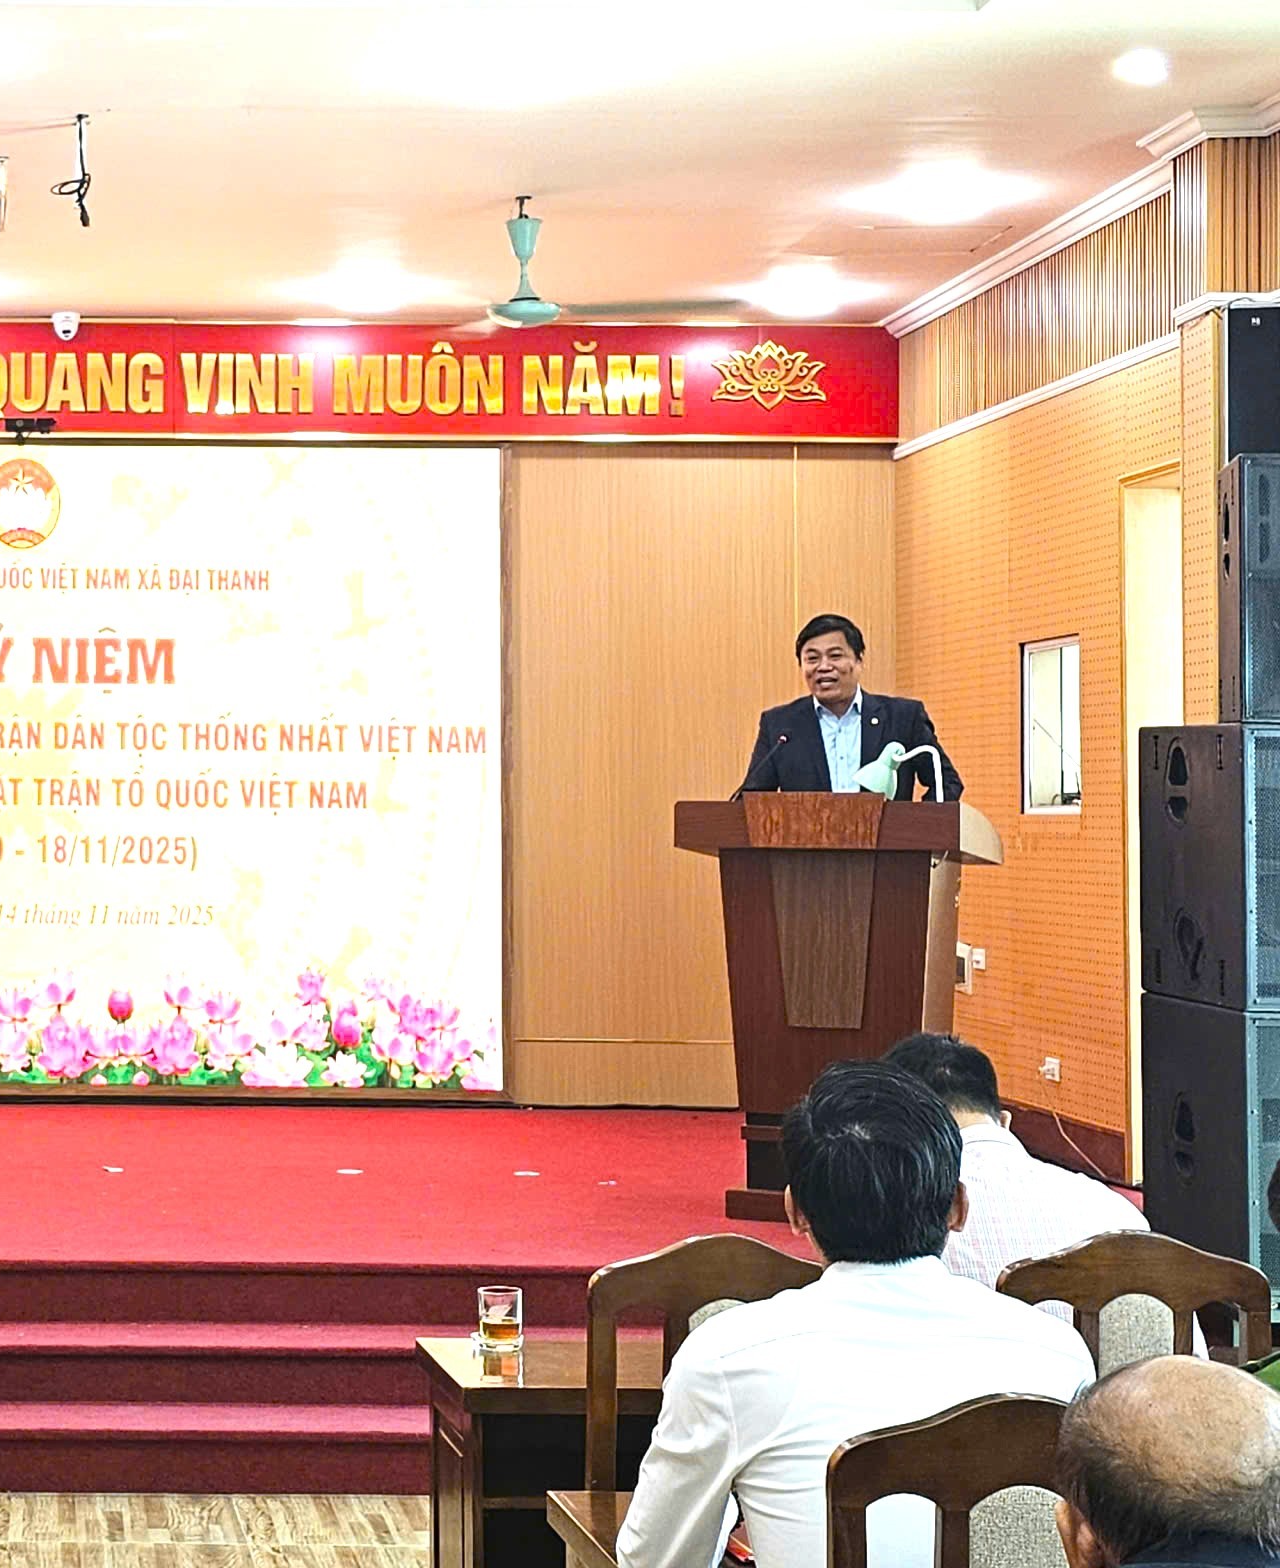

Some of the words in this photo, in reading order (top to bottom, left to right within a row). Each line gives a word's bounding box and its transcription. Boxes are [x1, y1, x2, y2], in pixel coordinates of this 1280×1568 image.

[180, 352, 314, 417] VINH
[332, 341, 505, 416] MUÔN
[40, 562, 79, 594] VIỆT
[86, 567, 131, 590] NAM
[138, 563, 162, 590] XÃ
[169, 568, 200, 595] ĐẠI
[207, 568, 269, 590] THANH
[32, 627, 176, 694] NIỆM
[54, 714, 105, 749] DÂN
[116, 714, 168, 758] TỘC
[178, 711, 268, 751] THỐNG
[279, 712, 349, 752] NHẤT
[358, 717, 418, 760] VIỆT
[428, 725, 487, 754] NAM
[33, 770, 101, 814] TRẬN
[111, 764, 145, 808] TỔ
[155, 768, 230, 811] QUỐC
[239, 772, 299, 816] VIỆT
[308, 780, 368, 809] NAM
[36, 834, 198, 871] 18/11/2025)
[89, 904, 110, 925] 11
[168, 904, 214, 926] 2025
